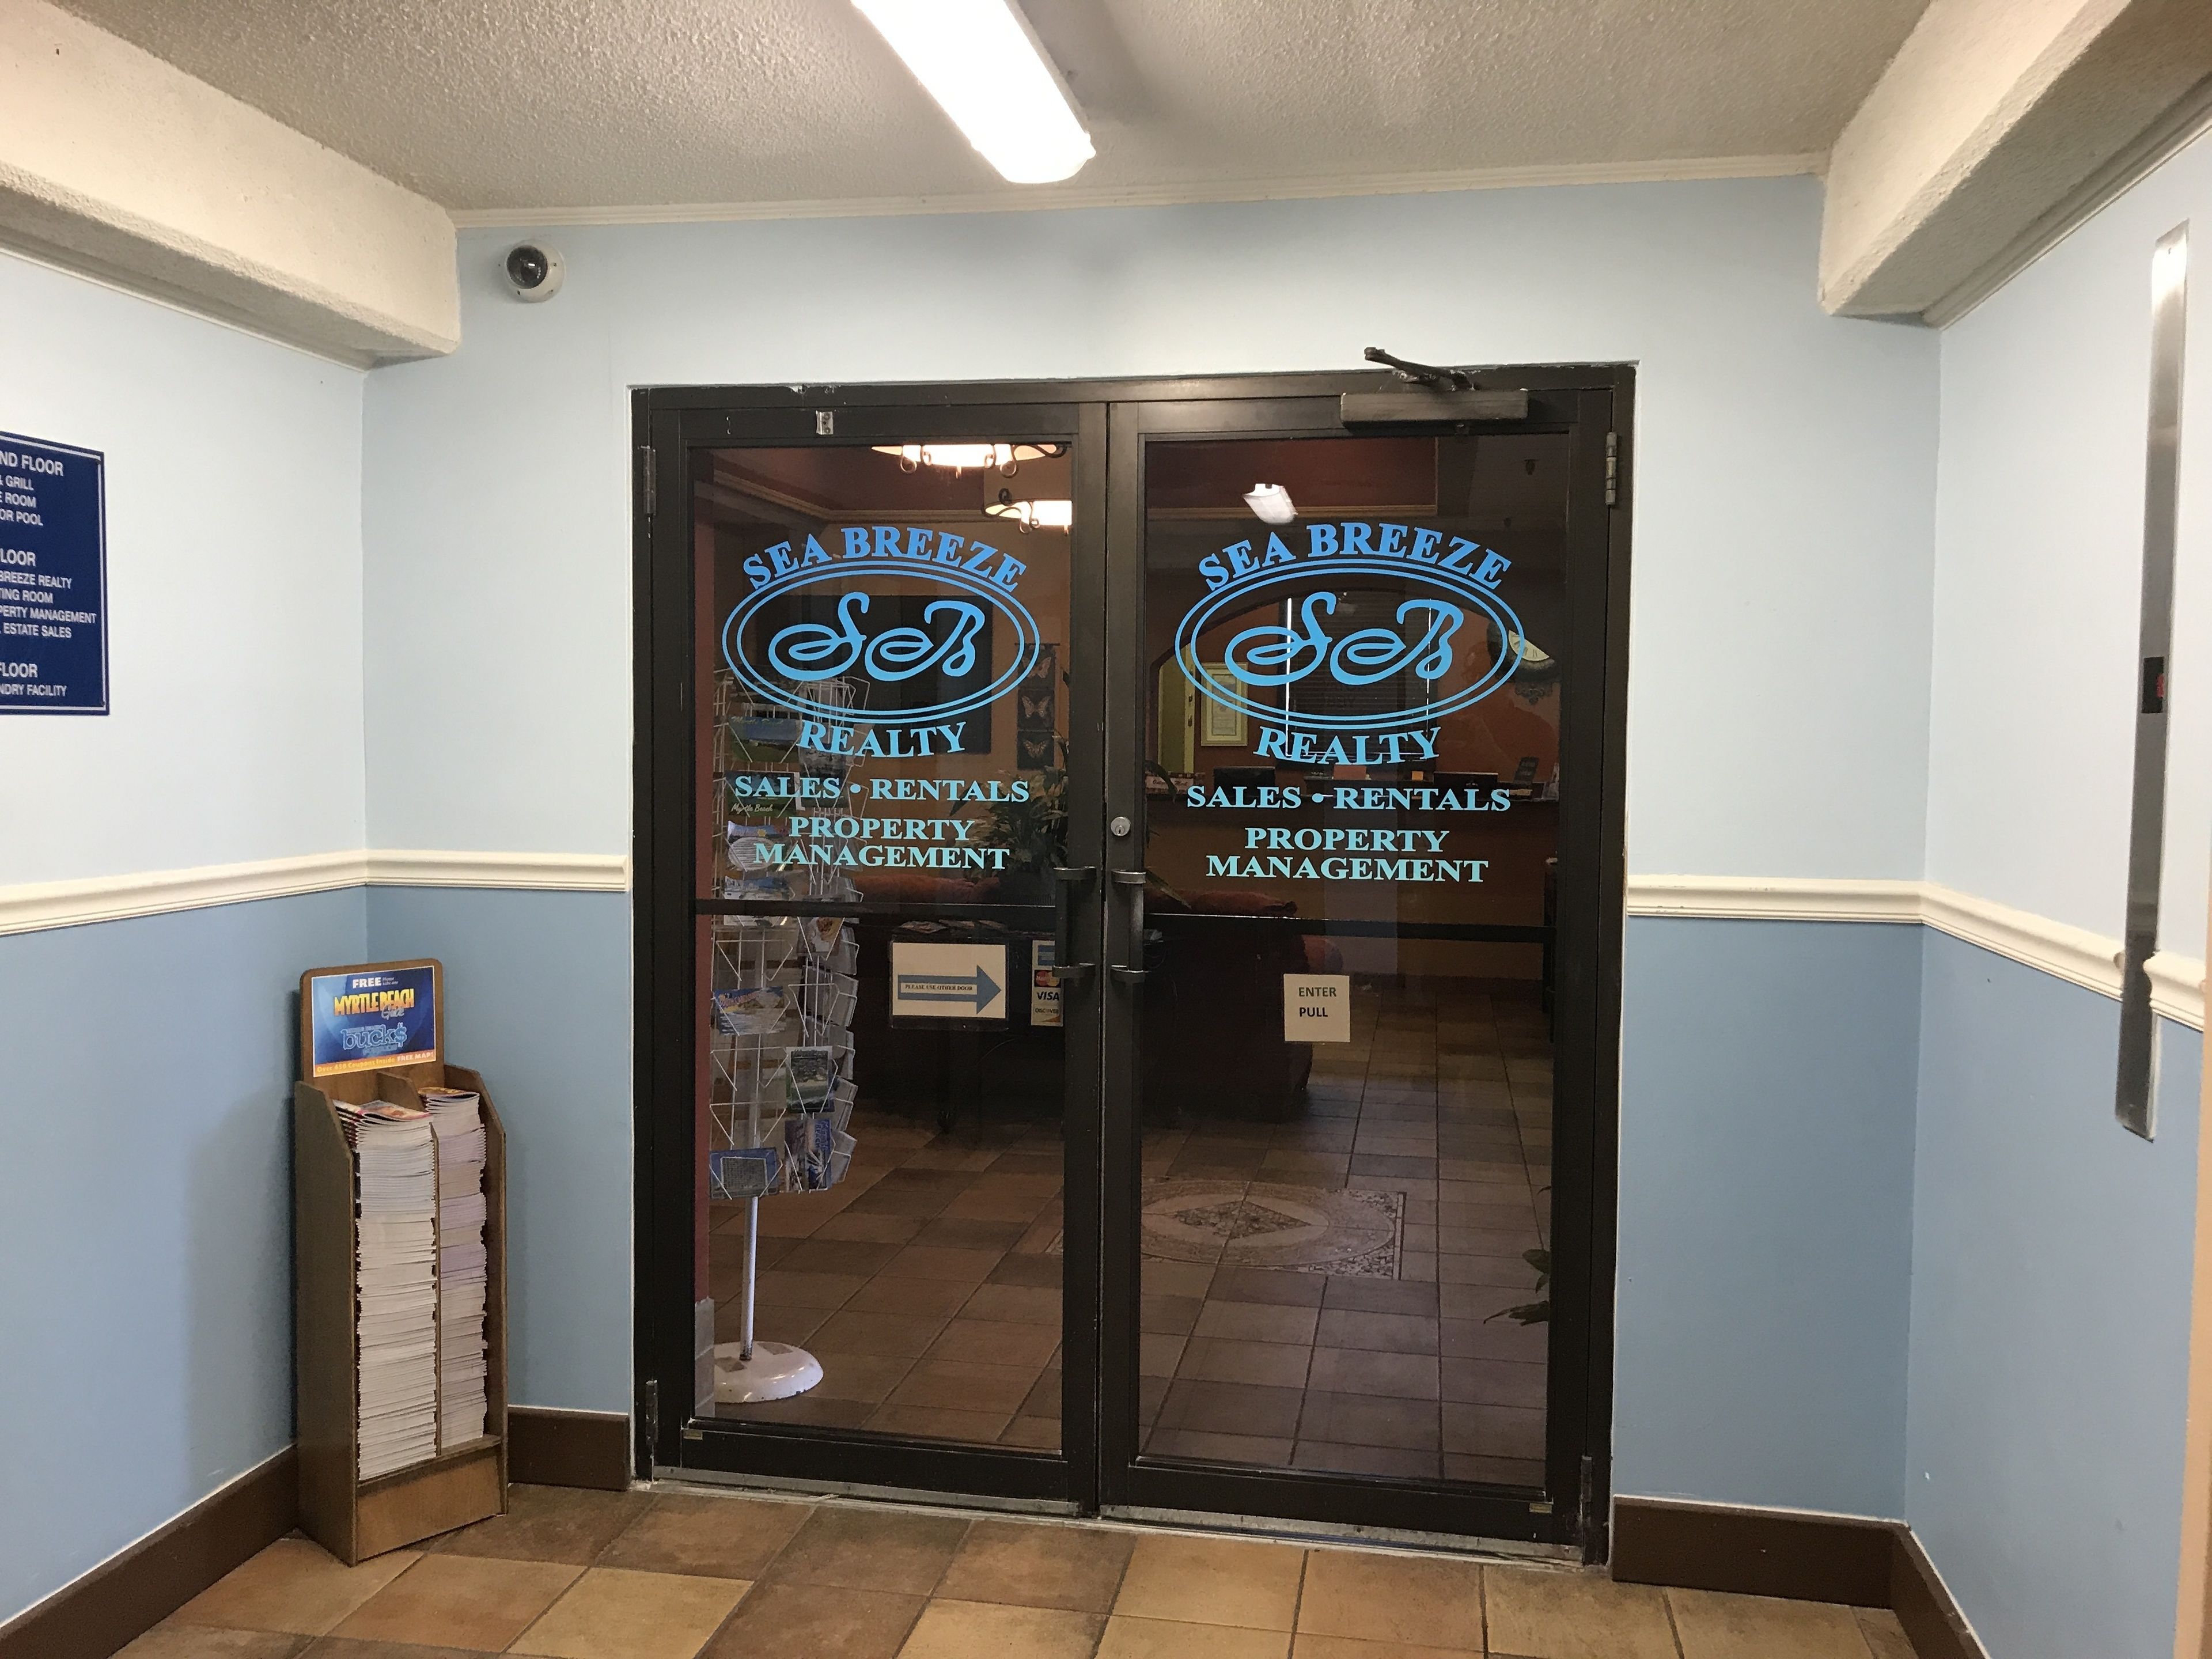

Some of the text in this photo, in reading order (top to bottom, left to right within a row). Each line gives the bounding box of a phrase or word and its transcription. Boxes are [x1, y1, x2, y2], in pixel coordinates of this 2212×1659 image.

[21, 454, 64, 476] FLOOR
[5, 475, 34, 491] GRILL
[5, 491, 36, 508] ROOM
[16, 510, 43, 526] POOL
[743, 525, 1026, 593] SEA BREEZE
[1199, 522, 1512, 591] SEA BREEZE
[38, 574, 72, 589] REALTY
[22, 589, 54, 604] ROOM
[30, 607, 97, 623] MANAGEMENT
[3, 622, 72, 638] ESTATE SALES
[27, 684, 67, 696] FACILITY
[796, 719, 967, 757] REALTY
[1253, 726, 1441, 766] REALTY
[734, 776, 1029, 802] SALES RENTALS
[1187, 786, 1511, 812] SALES RENTALS
[789, 816, 975, 840] PROPERTY
[1244, 827, 1449, 853] PROPERTY
[753, 843, 1010, 870] MANAGEMENT
[1206, 855, 1488, 882] MANAGEMENT
[353, 977, 382, 988] FREE
[1298, 987, 1337, 997] ENTER
[334, 988, 415, 1016] MYRTLE BEACH
[1037, 991, 1060, 1001] VISA
[1299, 1007, 1328, 1017] PULL
